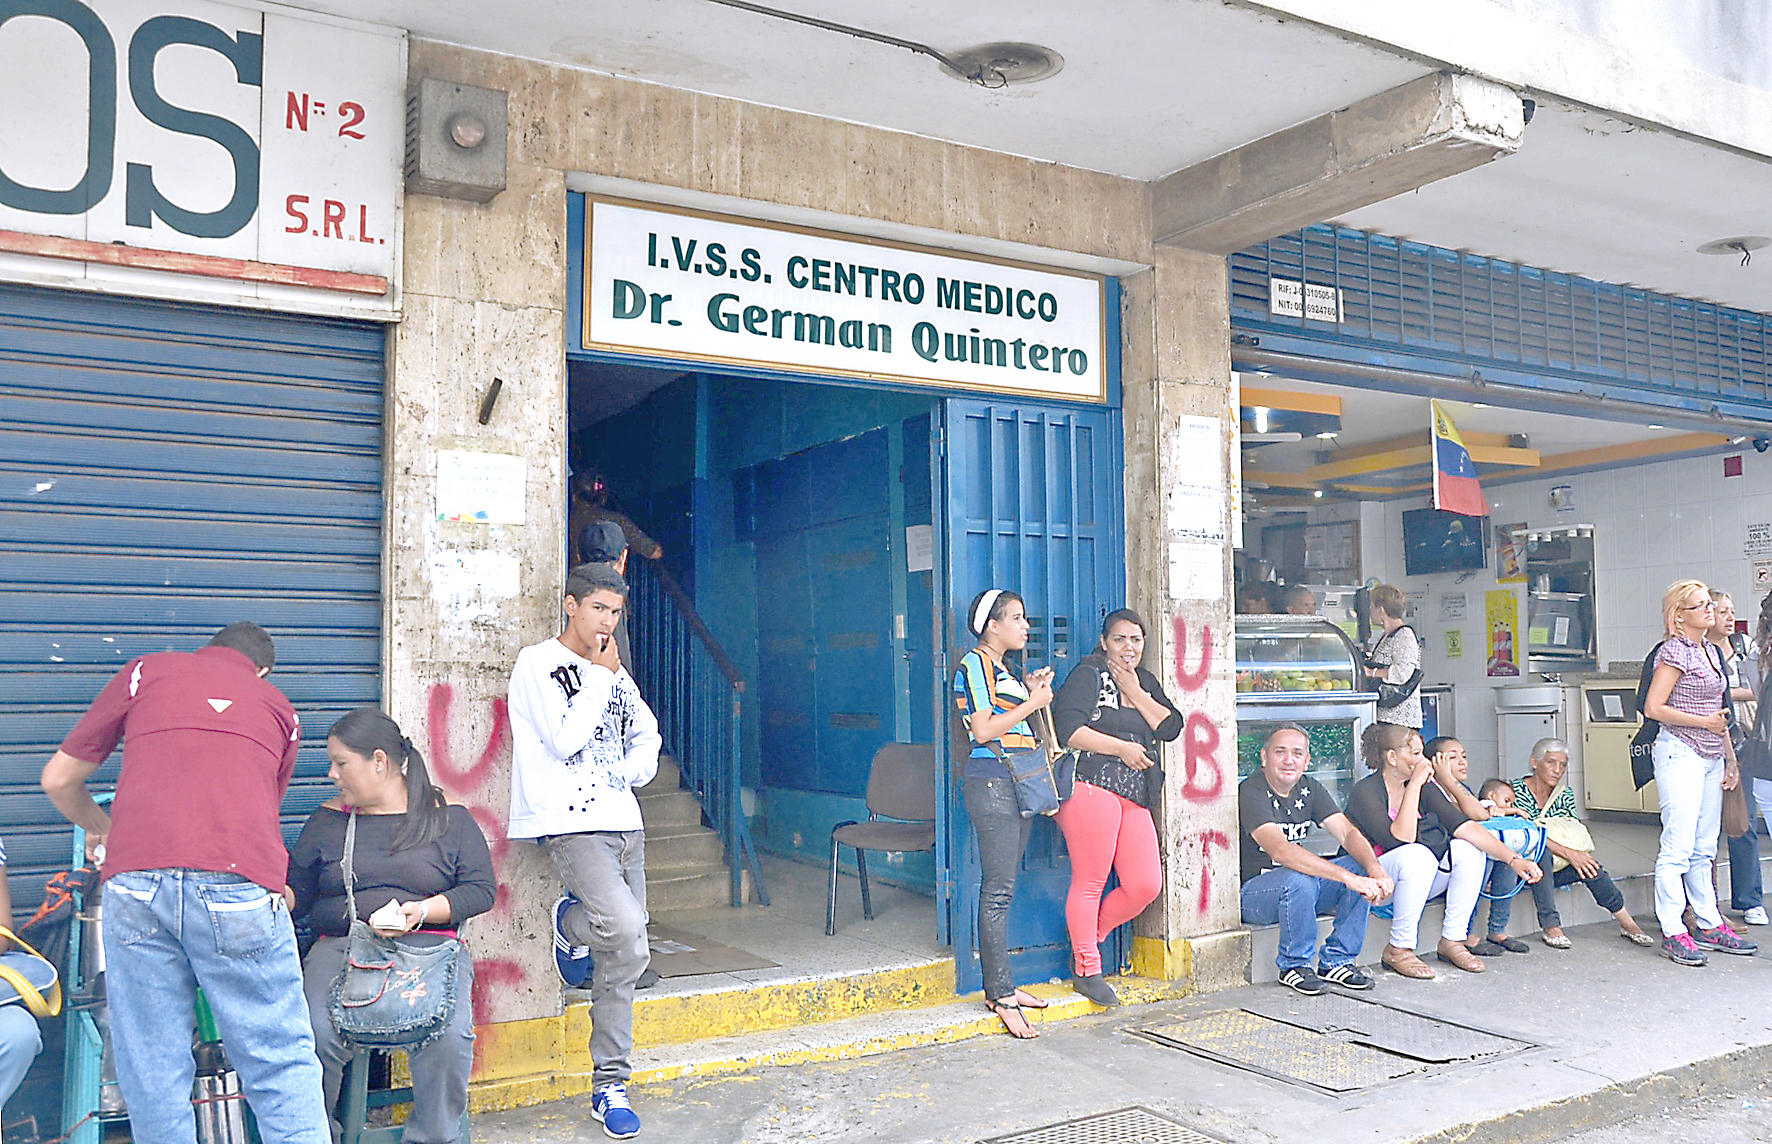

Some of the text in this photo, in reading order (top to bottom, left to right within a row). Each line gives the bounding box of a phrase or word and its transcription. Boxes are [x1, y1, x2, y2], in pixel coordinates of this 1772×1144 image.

[338, 101, 366, 140] 2
[285, 194, 385, 245] S.R.L.
[647, 232, 1058, 323] I.V.S.S. CENTRO MEDICO
[1278, 284, 1292, 294] RIF:
[1278, 299, 1293, 310] NIT:
[612, 278, 1089, 377] Dr. German Quintero
[1749, 532, 1761, 540] 100
